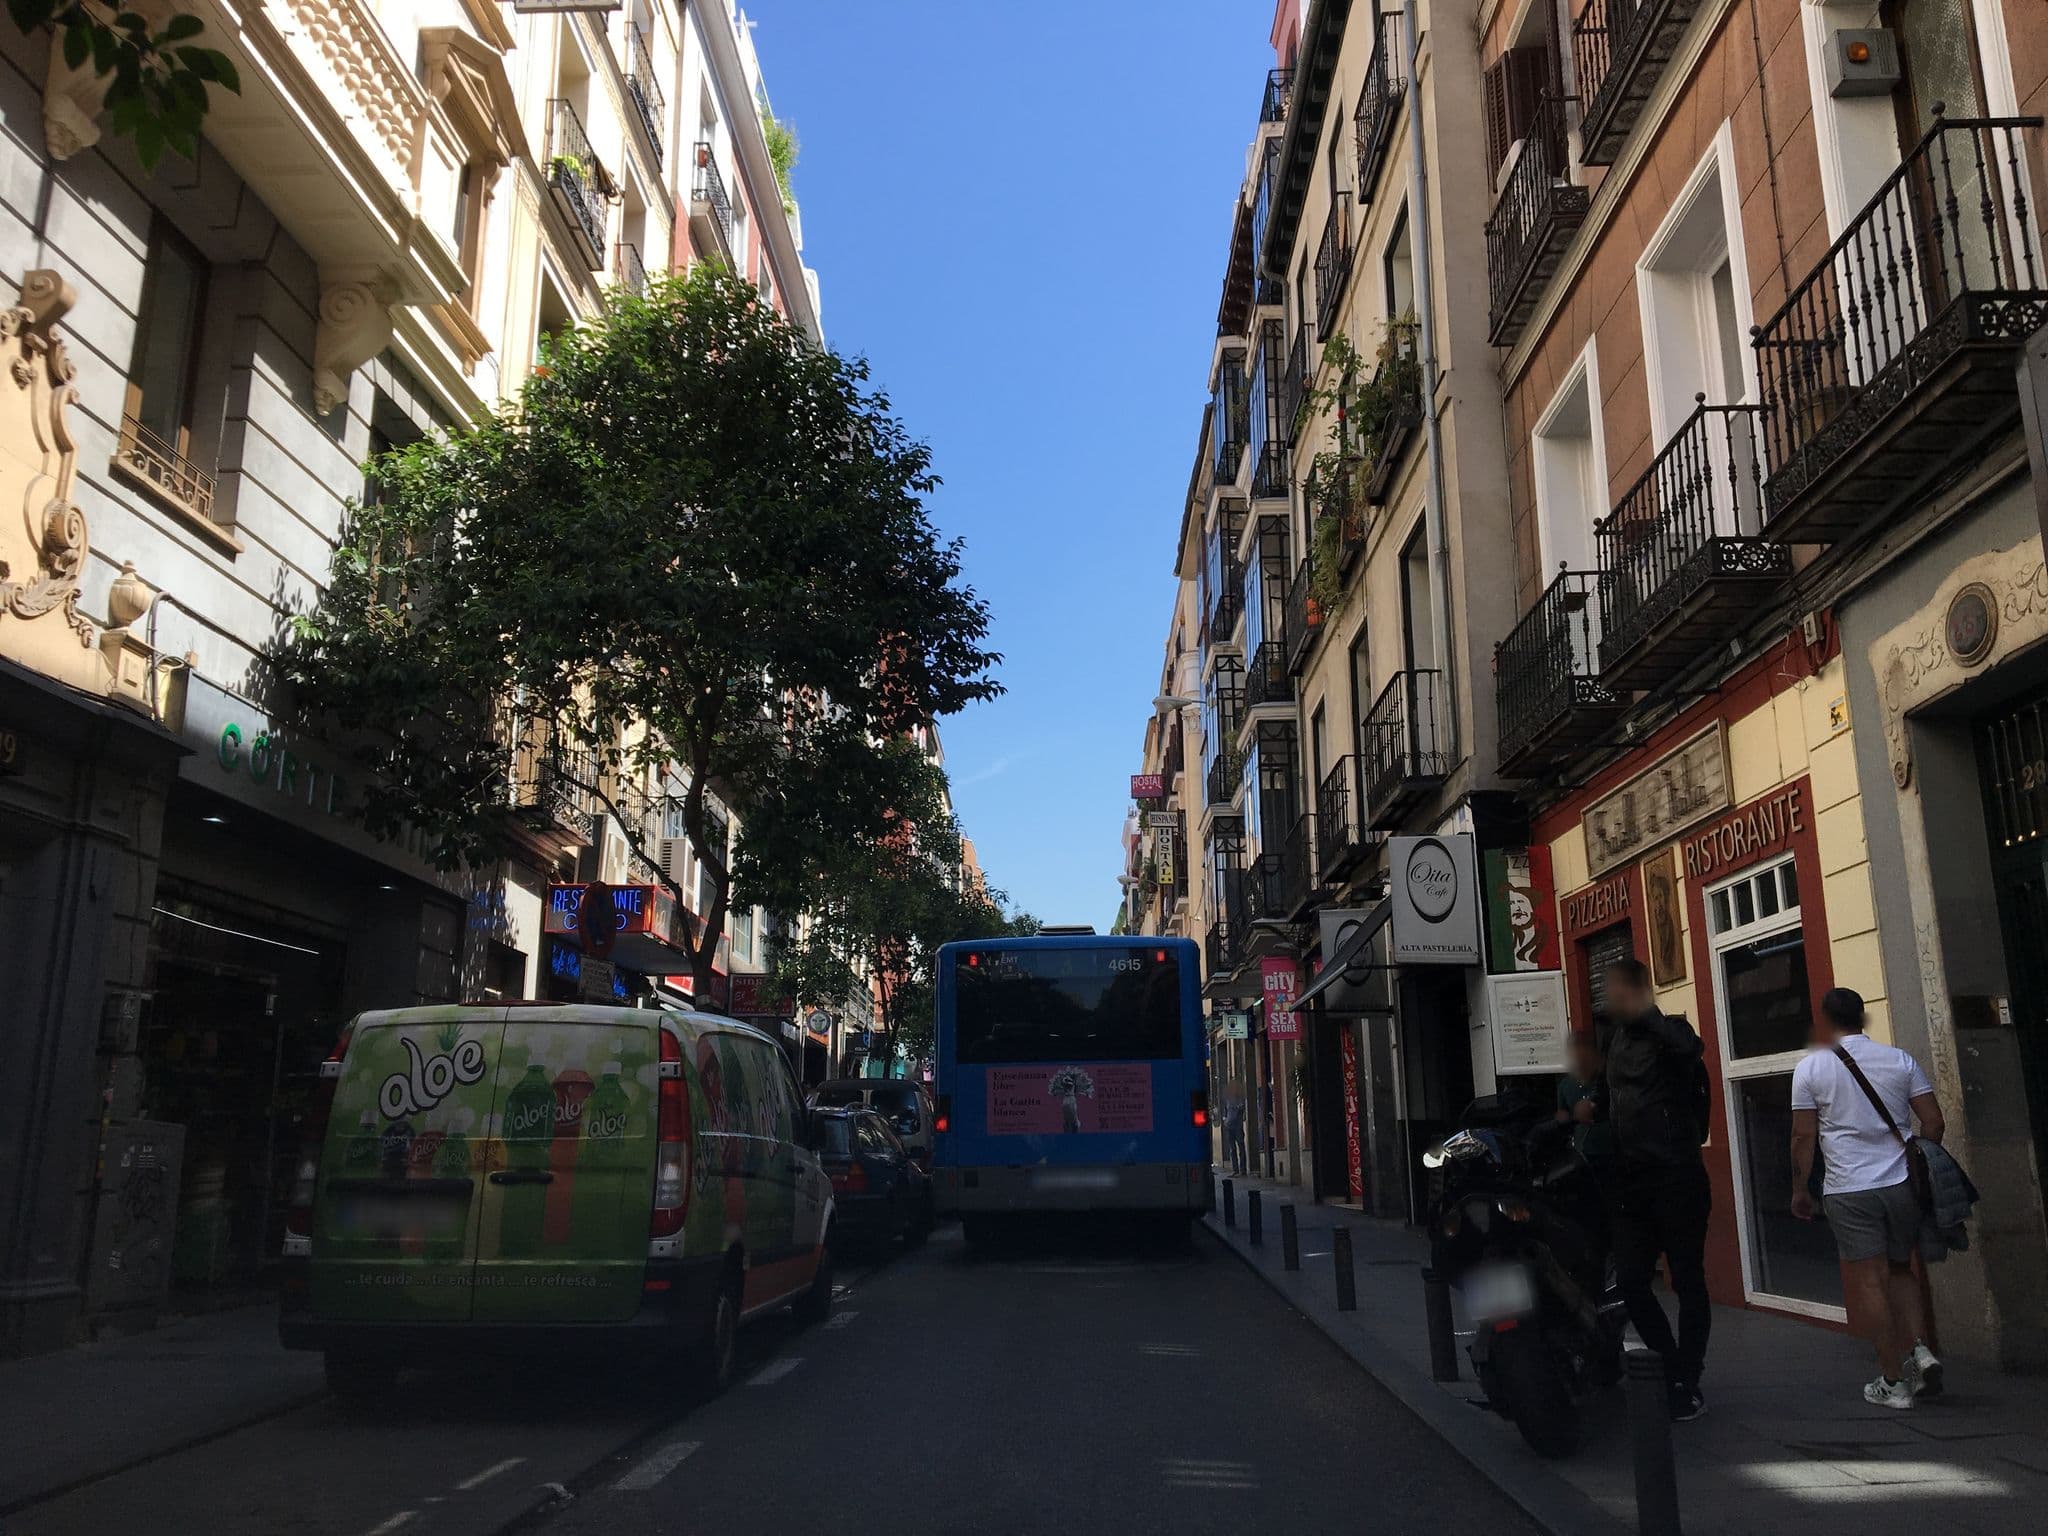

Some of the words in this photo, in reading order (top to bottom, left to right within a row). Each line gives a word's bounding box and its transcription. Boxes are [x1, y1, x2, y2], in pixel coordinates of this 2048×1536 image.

[0, 731, 16, 763] 9
[1132, 776, 1162, 788] HOSTAL
[1151, 814, 1177, 825] HISPANO
[1686, 789, 1804, 880] RISTORANTE
[1160, 828, 1171, 876] HOSTAL
[1410, 861, 1451, 884] Oita
[1568, 877, 1631, 930] PIZZERIA
[1400, 944, 1421, 952] ALTA
[1108, 958, 1142, 972] 4615
[1265, 971, 1295, 992] city
[1270, 1012, 1296, 1025] SEX
[1271, 1024, 1297, 1033] STORE
[378, 1036, 487, 1121] aloe
[554, 1096, 580, 1122] alo
